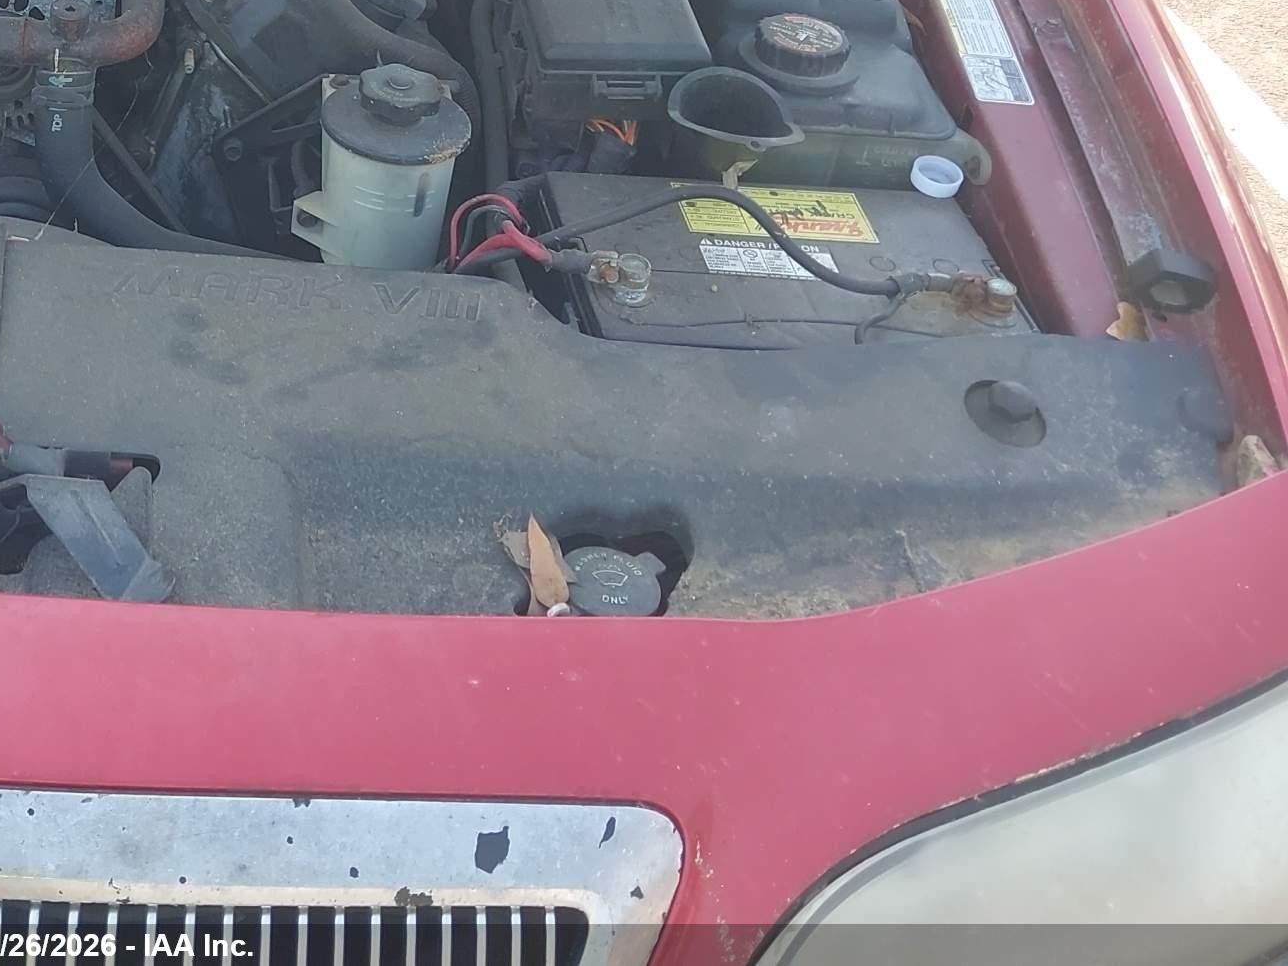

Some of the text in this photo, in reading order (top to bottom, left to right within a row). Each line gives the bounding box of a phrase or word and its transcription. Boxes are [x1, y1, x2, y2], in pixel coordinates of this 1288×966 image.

[51, 113, 63, 132] TOP
[714, 239, 766, 249] DANGER
[112, 270, 481, 322] MARK VIII
[601, 594, 629, 604] ONLY
